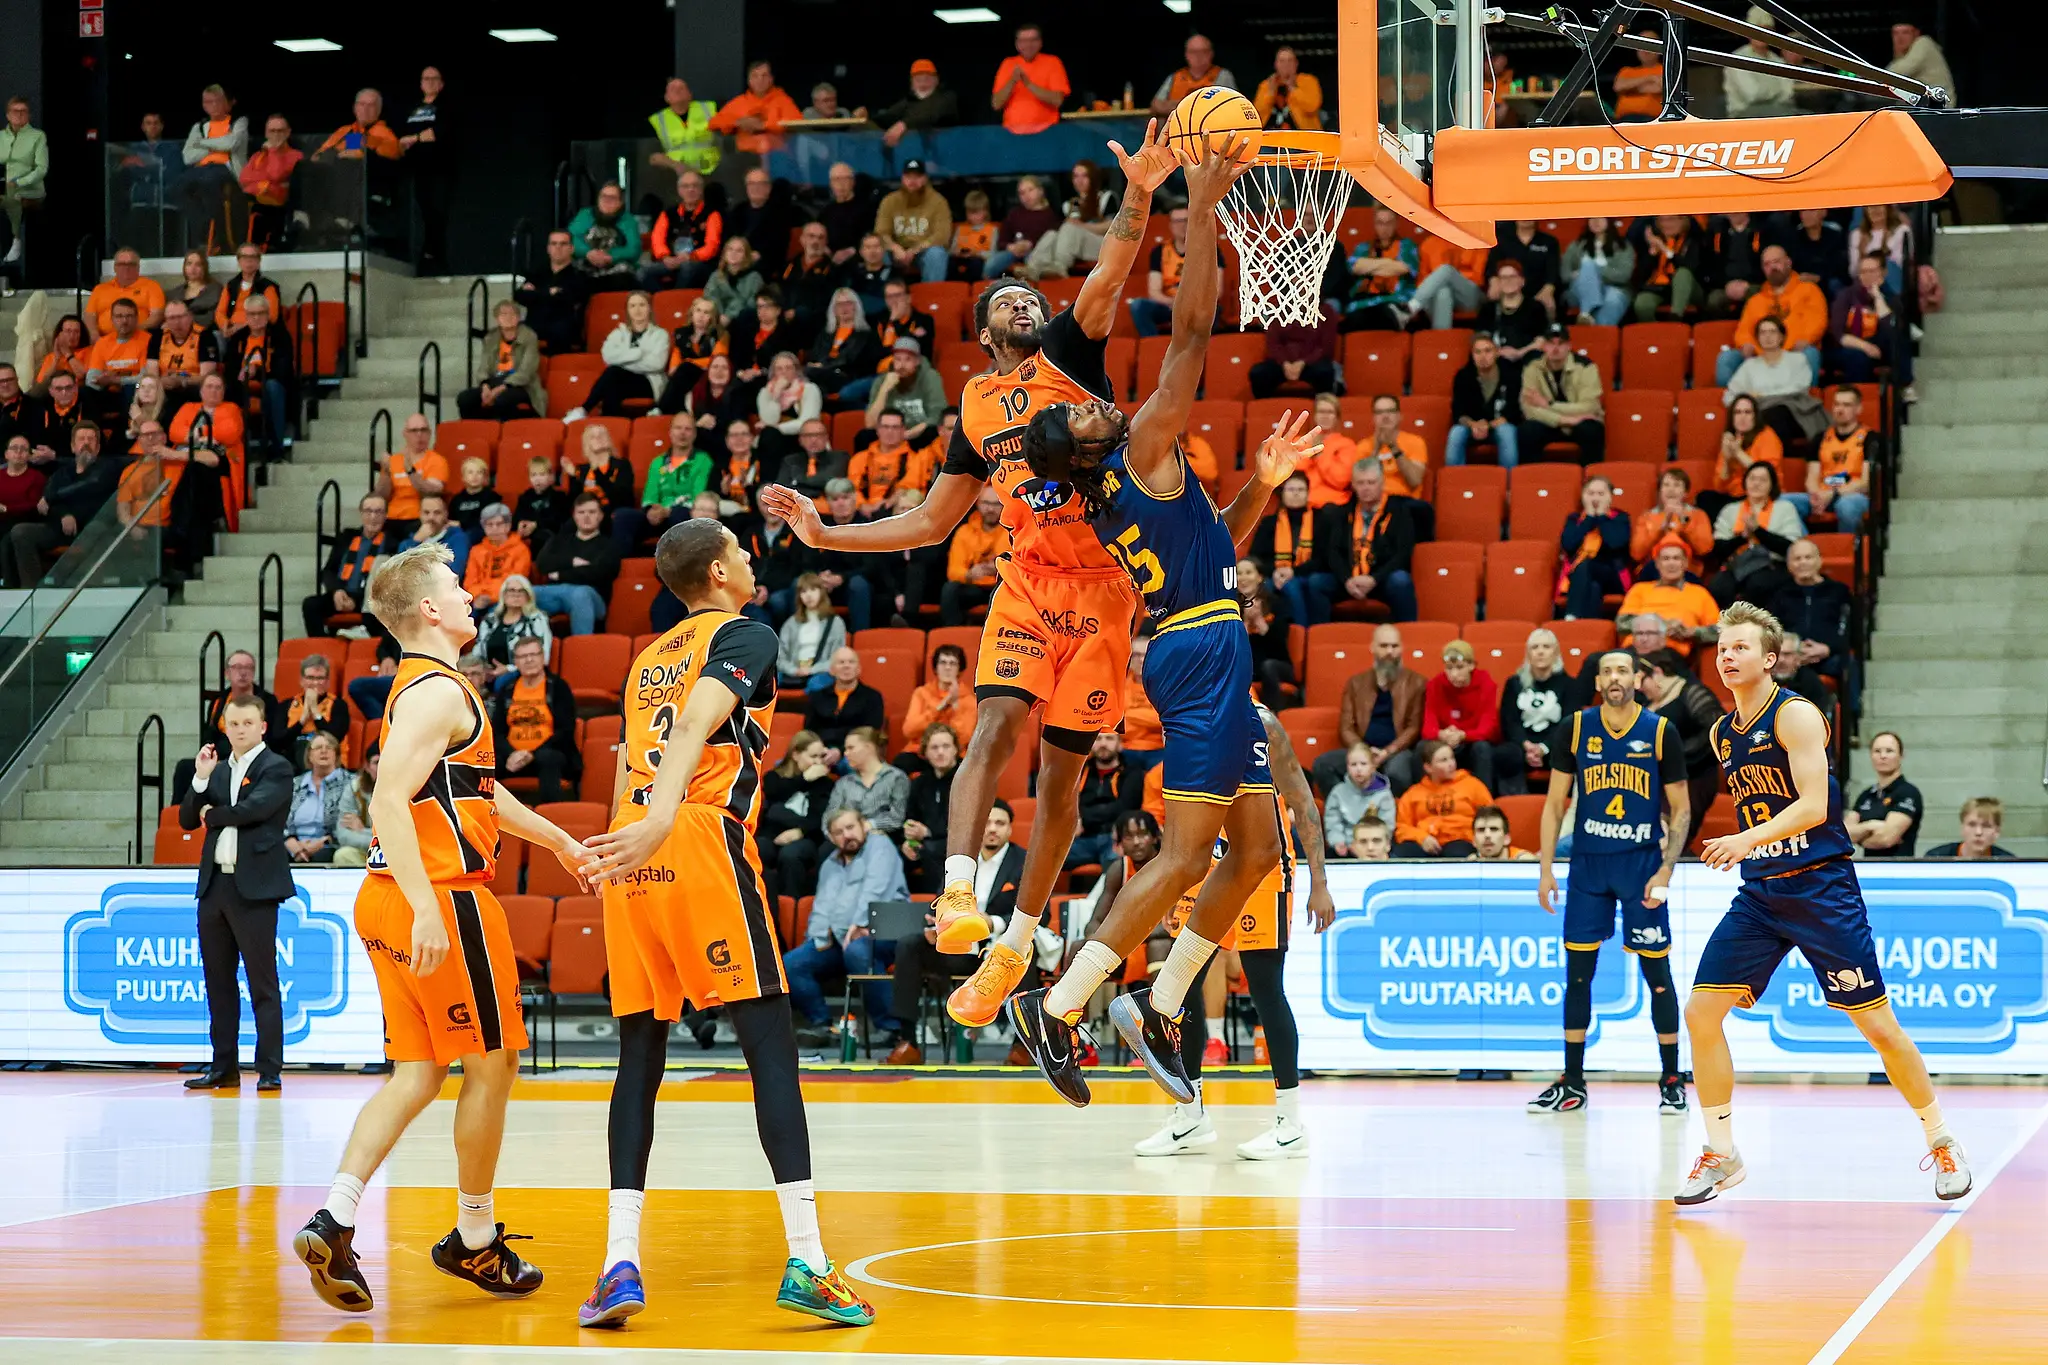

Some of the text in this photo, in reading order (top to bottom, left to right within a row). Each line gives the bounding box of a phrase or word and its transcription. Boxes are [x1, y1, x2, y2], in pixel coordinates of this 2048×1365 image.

[999, 386, 1030, 424] 10
[1583, 762, 1651, 800] HELSINKI
[1605, 793, 1626, 820] 4
[1742, 802, 1772, 829] 13
[1631, 925, 1669, 945] SOL
[1827, 966, 1875, 993] SOL
[1380, 981, 1568, 1006] PUUTARHA O
[1954, 983, 1998, 1008] OY
